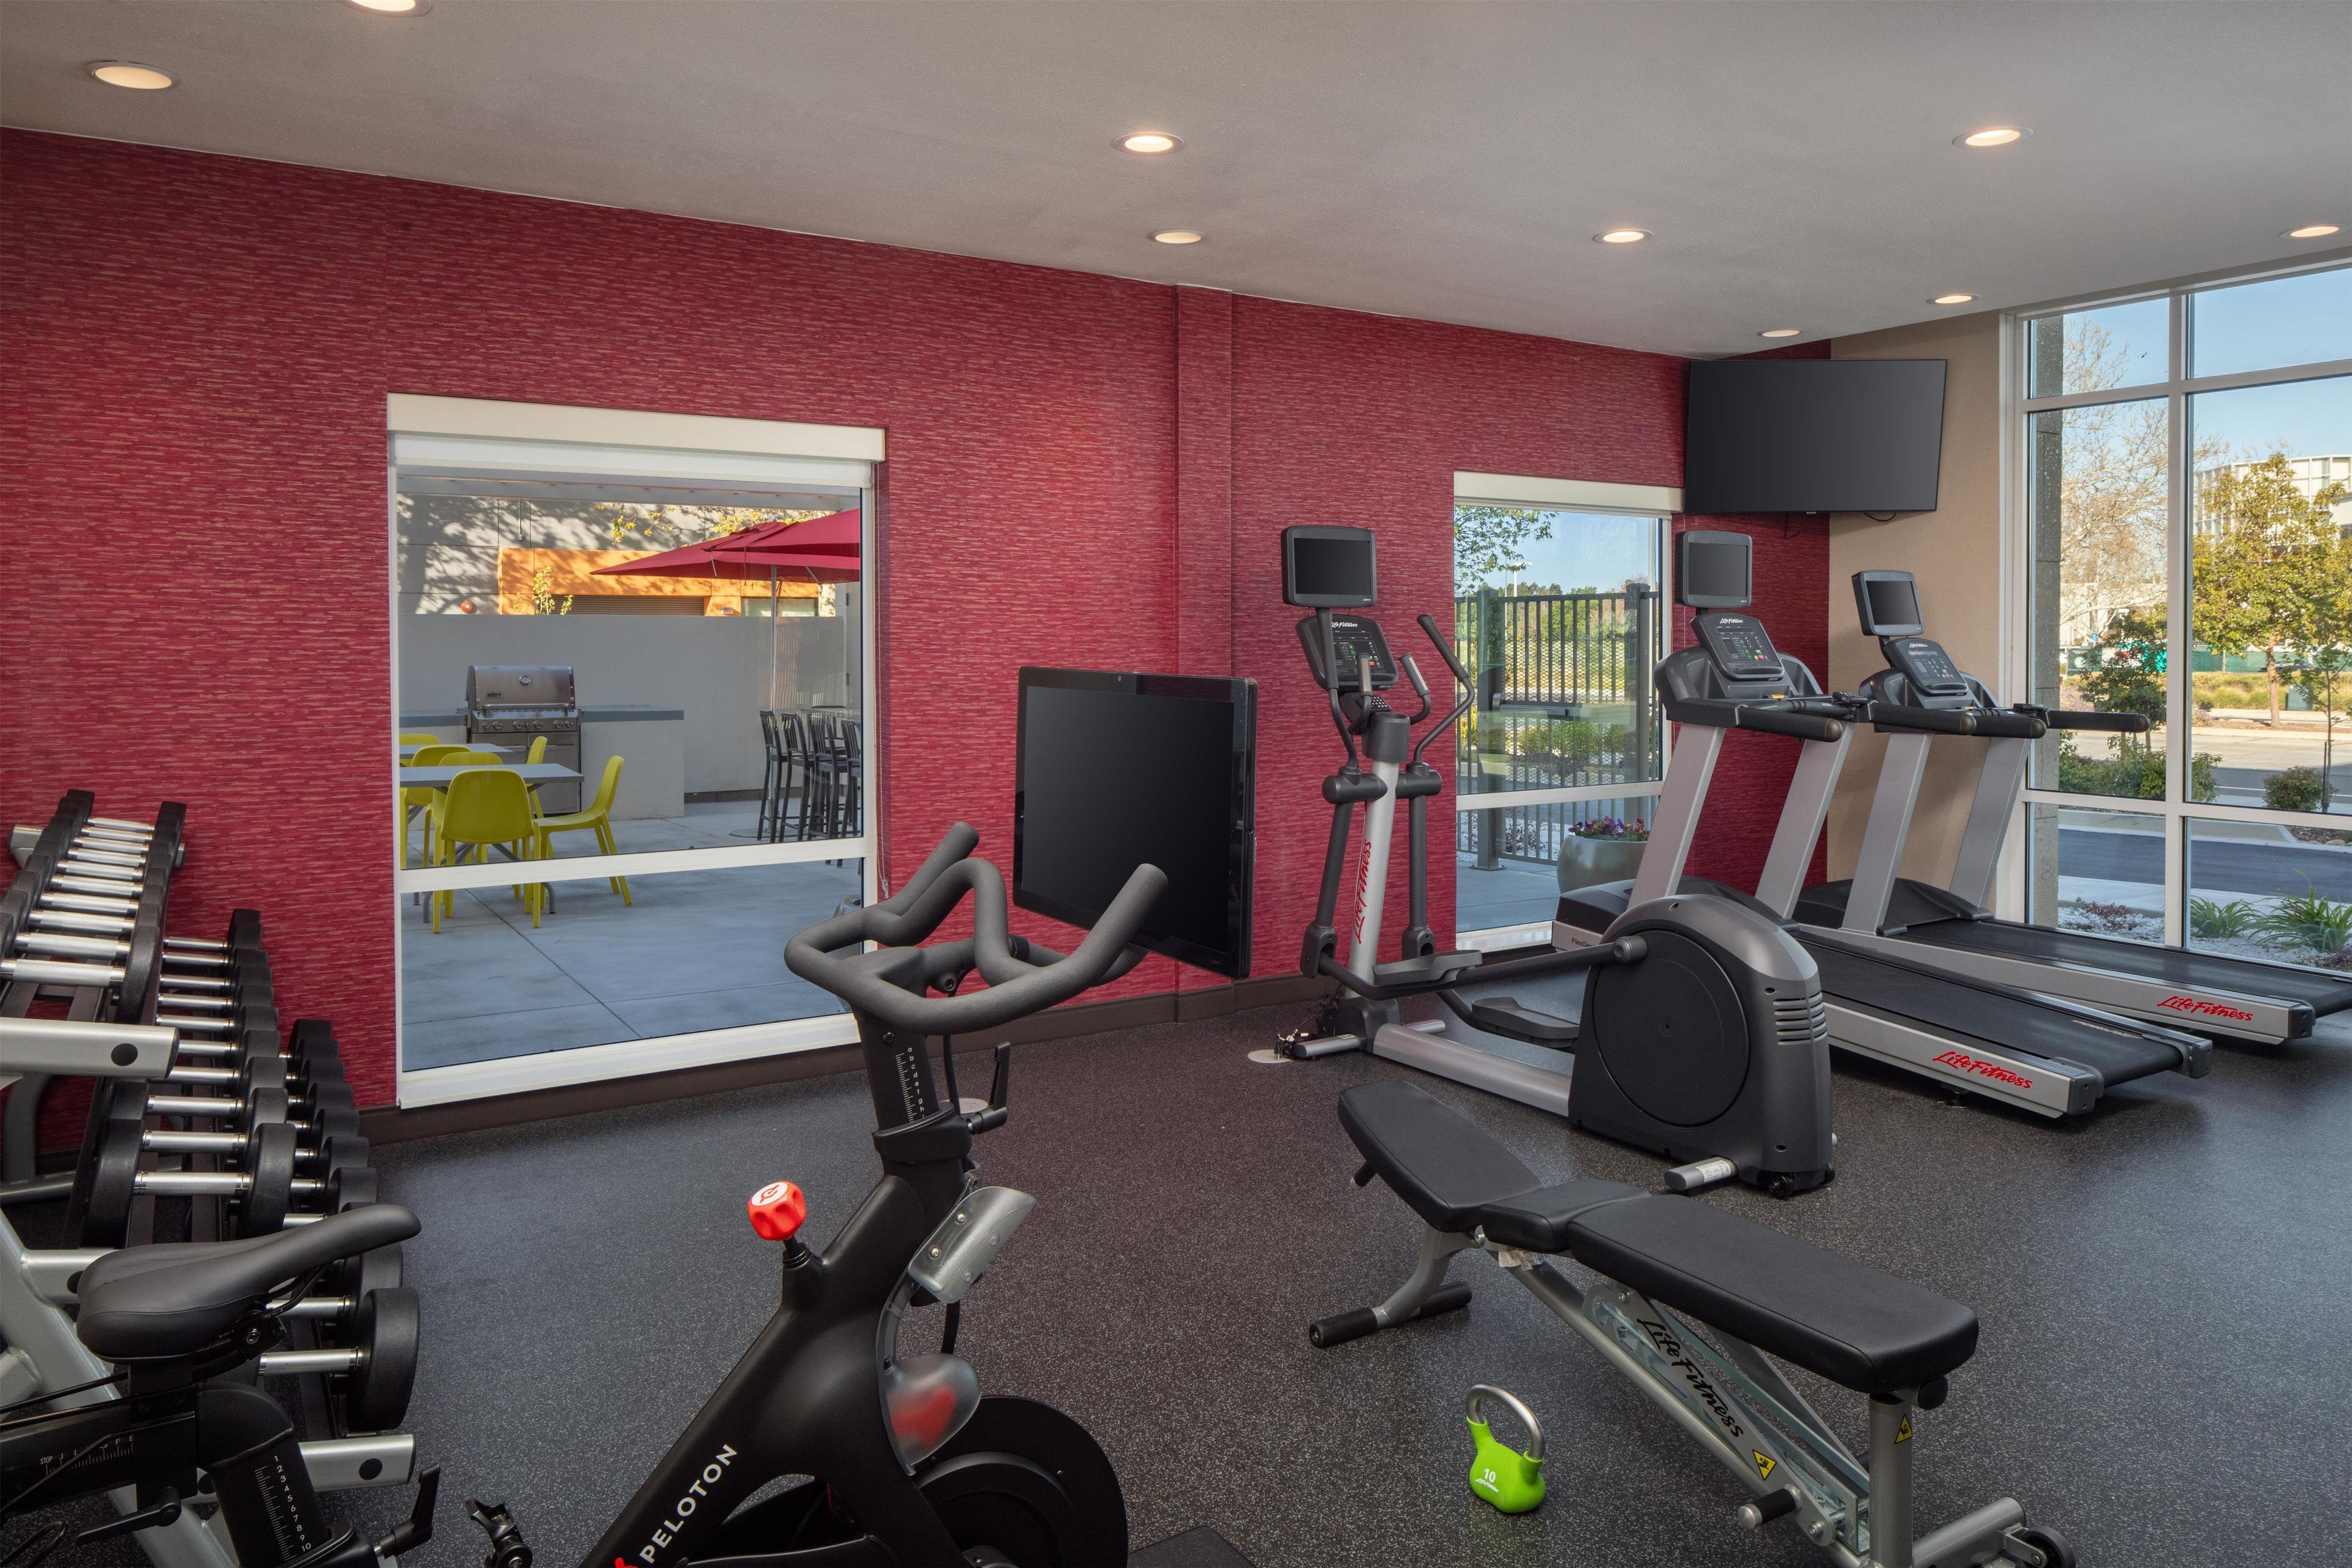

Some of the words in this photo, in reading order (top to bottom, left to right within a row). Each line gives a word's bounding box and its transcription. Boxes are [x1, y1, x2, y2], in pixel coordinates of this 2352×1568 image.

[1572, 938, 1596, 947] FlexDe
[40, 1456, 53, 1465] STOP
[1485, 1468, 1496, 1483] 10
[639, 1444, 737, 1563] PELOTON
[301, 1543, 311, 1552] 10
